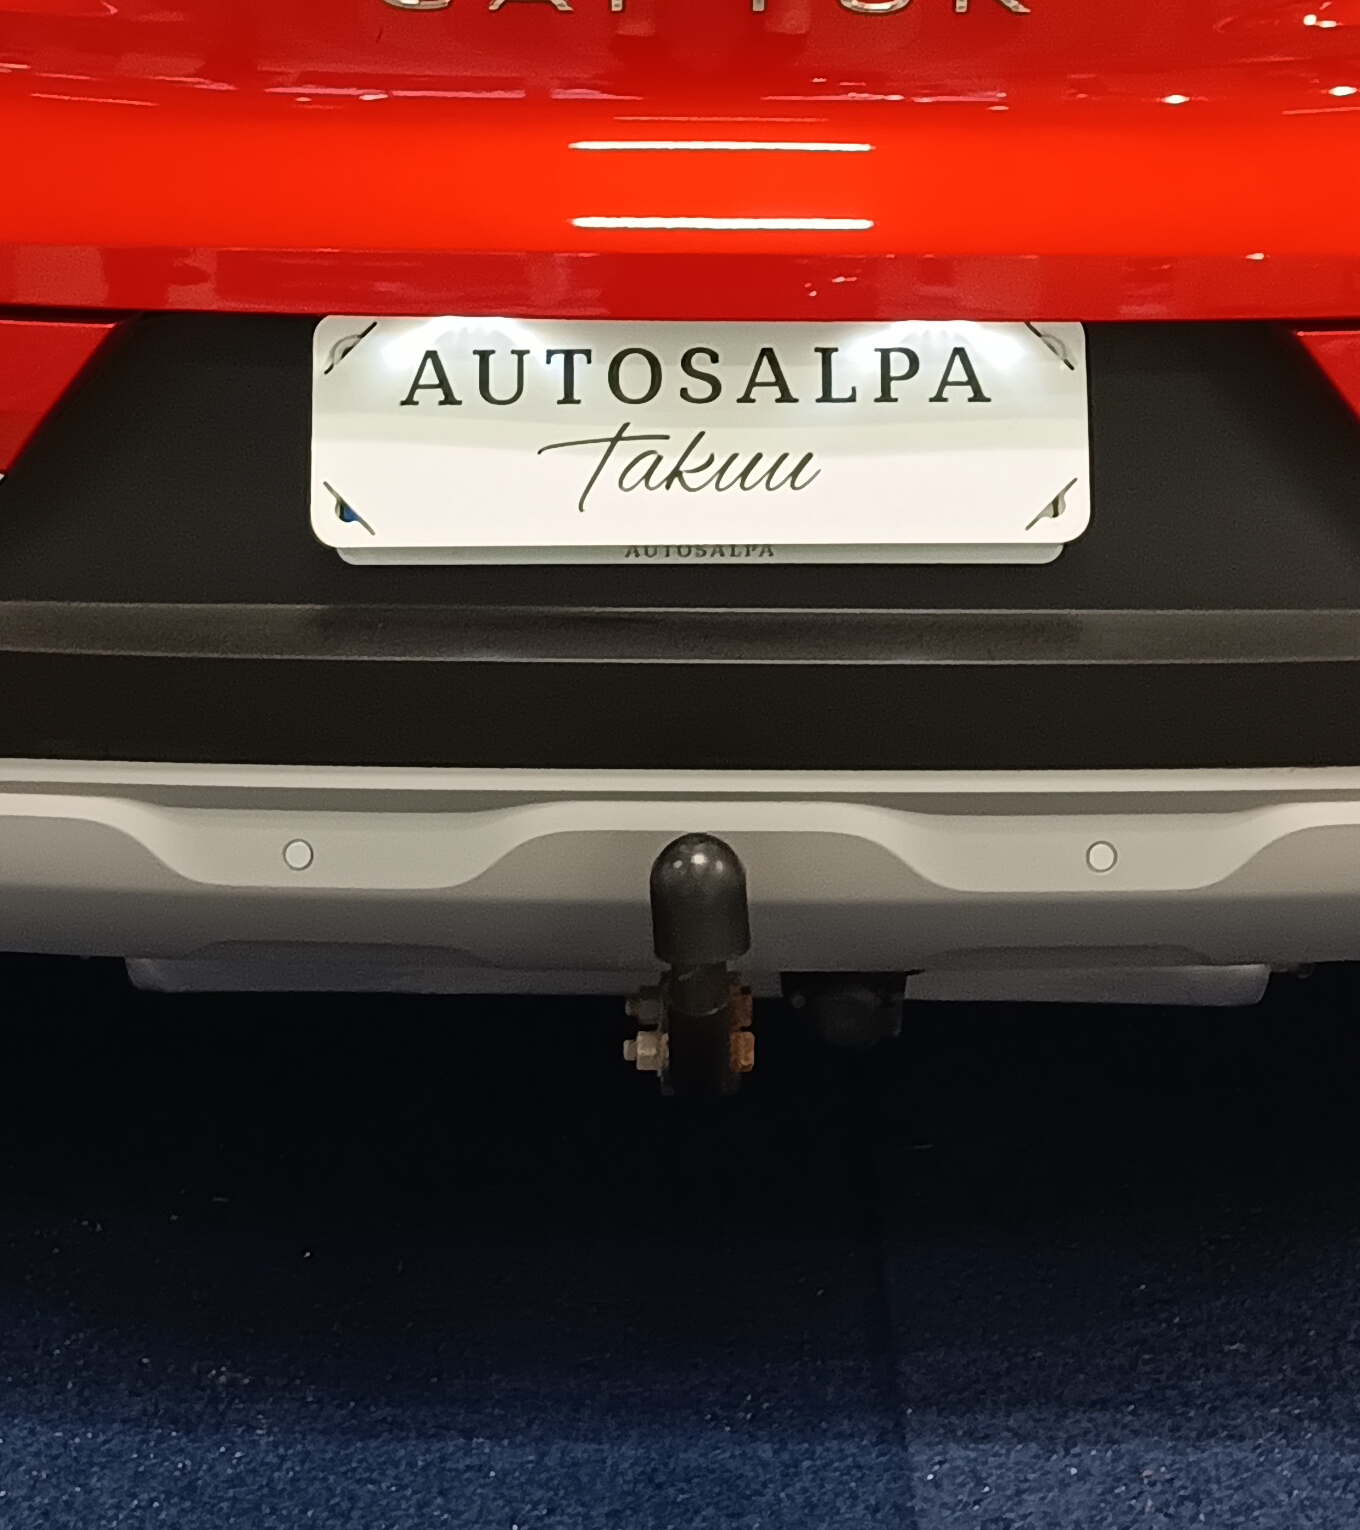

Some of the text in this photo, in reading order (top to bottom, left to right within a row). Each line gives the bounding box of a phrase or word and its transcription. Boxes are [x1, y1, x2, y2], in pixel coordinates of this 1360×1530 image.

[399, 346, 992, 406] AUTOSALPA
[537, 421, 822, 513] Takuu
[624, 544, 775, 559] AUTOSALPA
